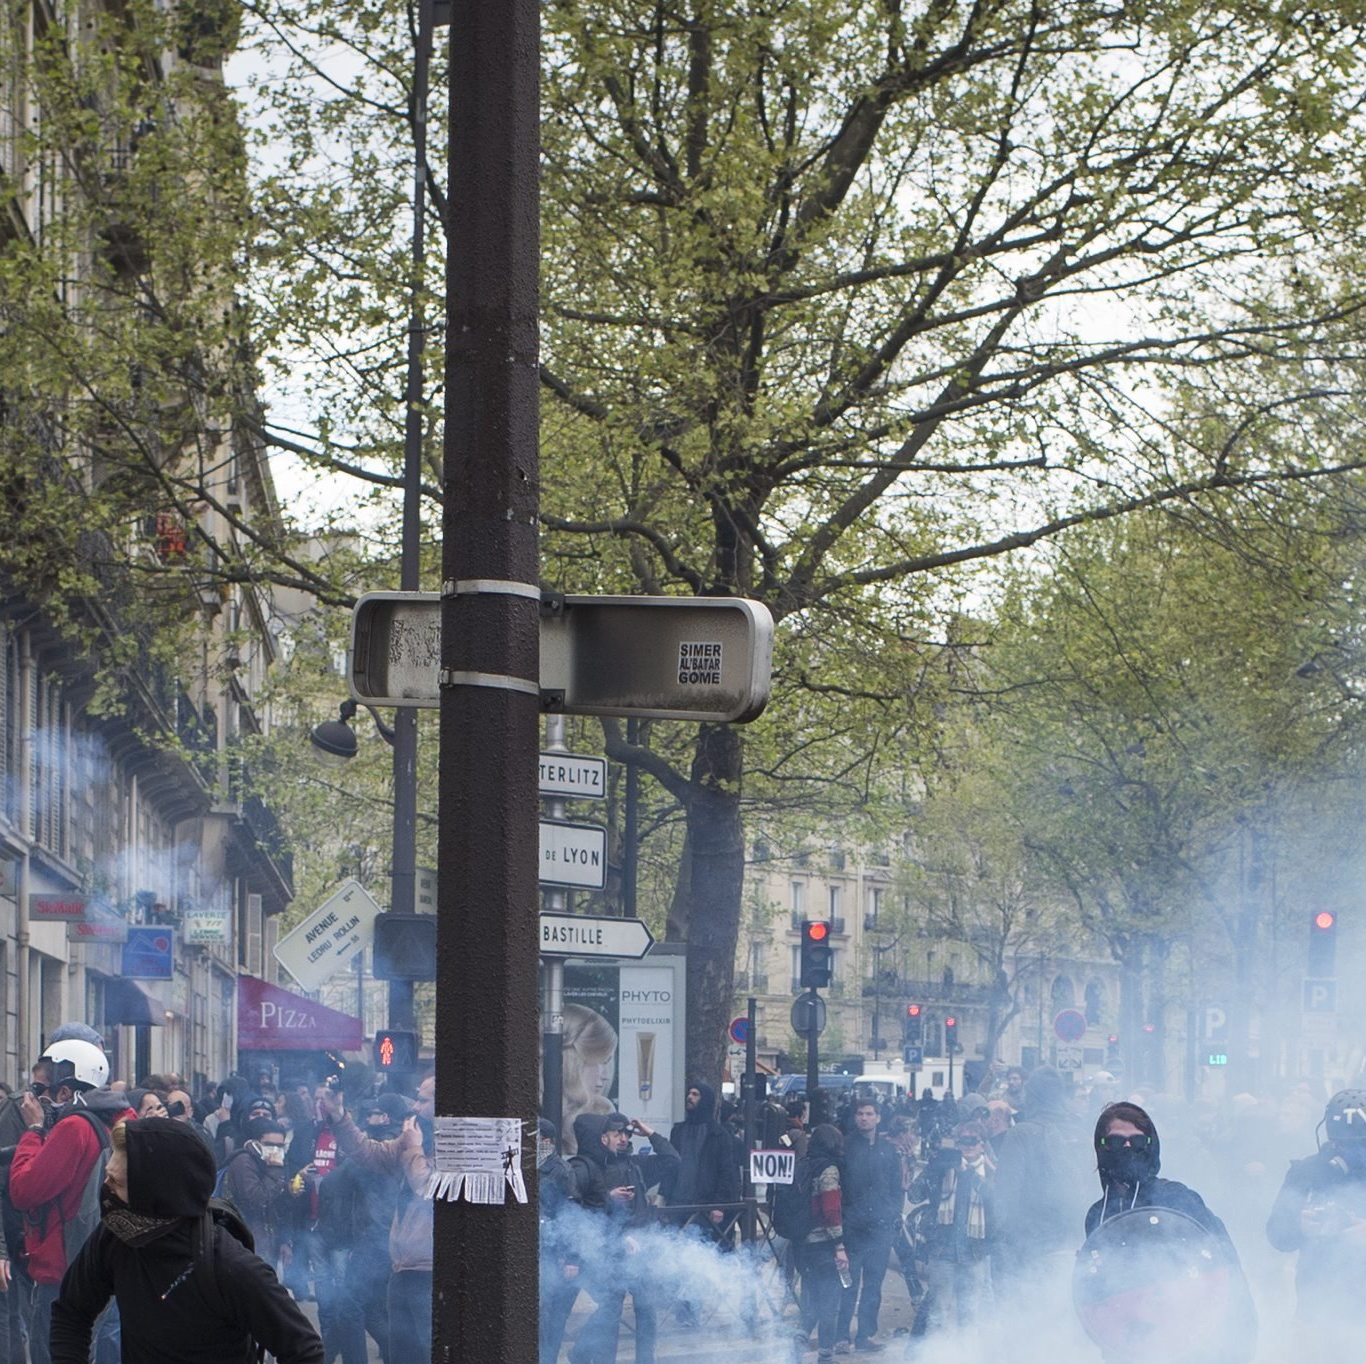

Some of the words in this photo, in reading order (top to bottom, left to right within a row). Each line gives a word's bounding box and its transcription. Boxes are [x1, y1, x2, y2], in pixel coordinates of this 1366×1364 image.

[680, 644, 721, 657] SIMER
[679, 671, 721, 684] GOME
[546, 850, 556, 861] DE
[564, 847, 599, 866] LYON
[305, 912, 338, 944] AVENUE
[543, 926, 603, 945] BASTILLE
[307, 939, 332, 964] LEDRU
[333, 915, 360, 941] ROLLIN
[622, 991, 671, 1002] PHYTO
[260, 1001, 317, 1029] PIZZA
[621, 1017, 671, 1025] PHYTOELIXIR
[909, 1049, 917, 1061] P
[753, 1154, 793, 1178] NON!
